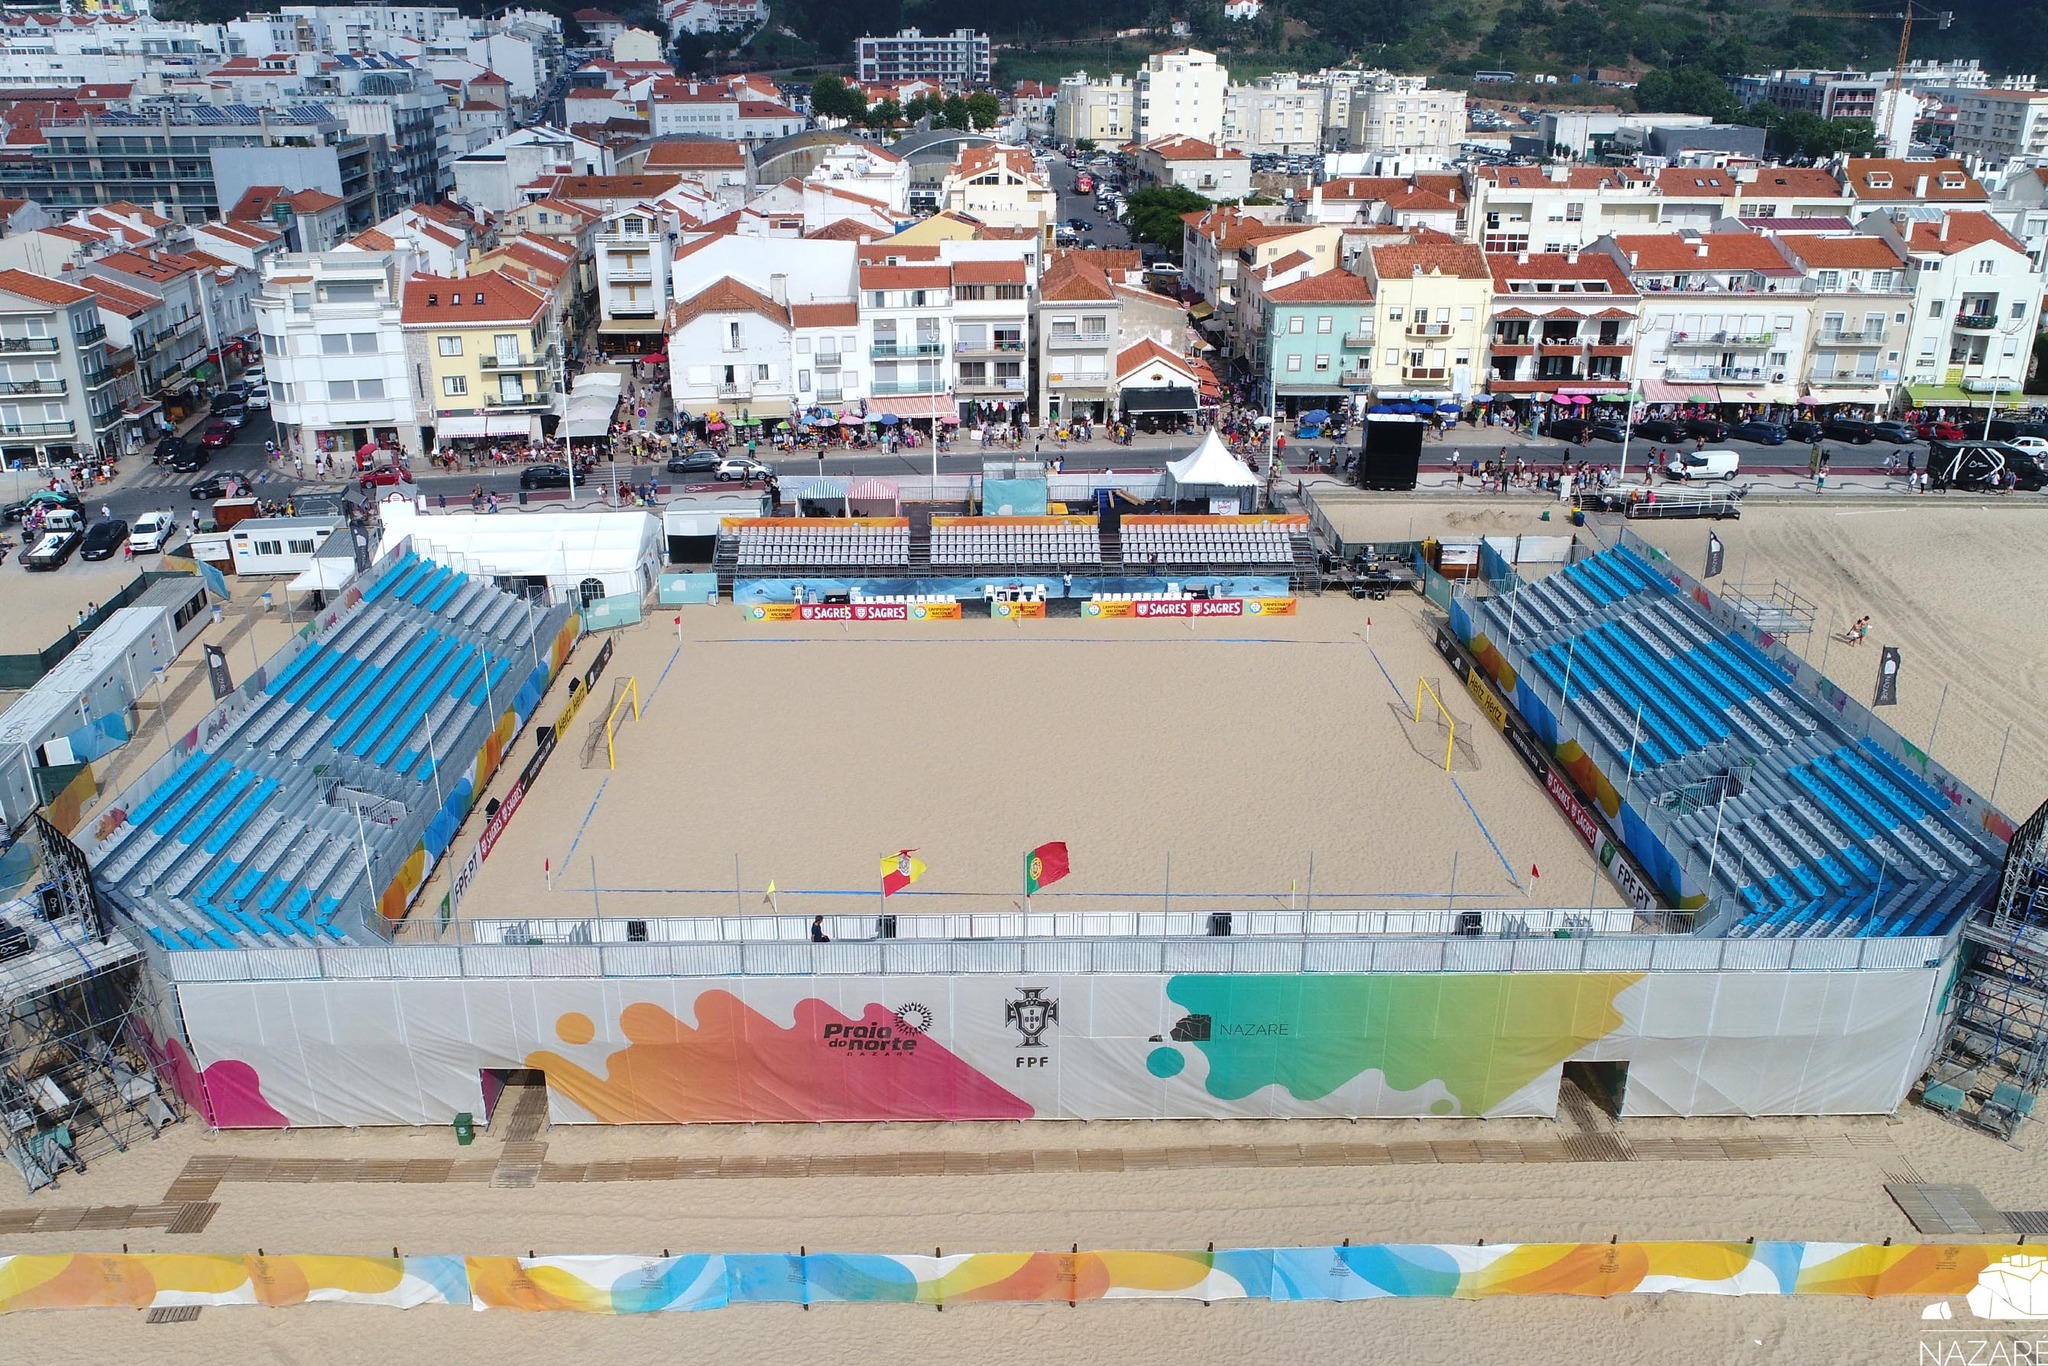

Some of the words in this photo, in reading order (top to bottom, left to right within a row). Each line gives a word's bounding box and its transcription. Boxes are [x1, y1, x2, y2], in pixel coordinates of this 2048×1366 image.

[814, 607, 852, 619] SAGRES
[868, 606, 905, 619] SAGRES
[1149, 602, 1187, 616] SAGRES
[1203, 602, 1240, 615] SAGRES
[1469, 675, 1485, 701] Hertz
[1485, 695, 1503, 722] Hertz
[486, 813, 503, 849] SAGRES
[506, 784, 523, 817] SAGRES
[1552, 778, 1571, 811] SAGRES
[1575, 808, 1596, 844] SAGRES
[454, 851, 479, 904] FPF.PT
[1617, 863, 1651, 909] FPF.PT
[824, 1021, 892, 1039] Praia
[828, 1037, 847, 1048] do
[848, 1037, 917, 1051] norte
[1015, 1056, 1049, 1068] FPF
